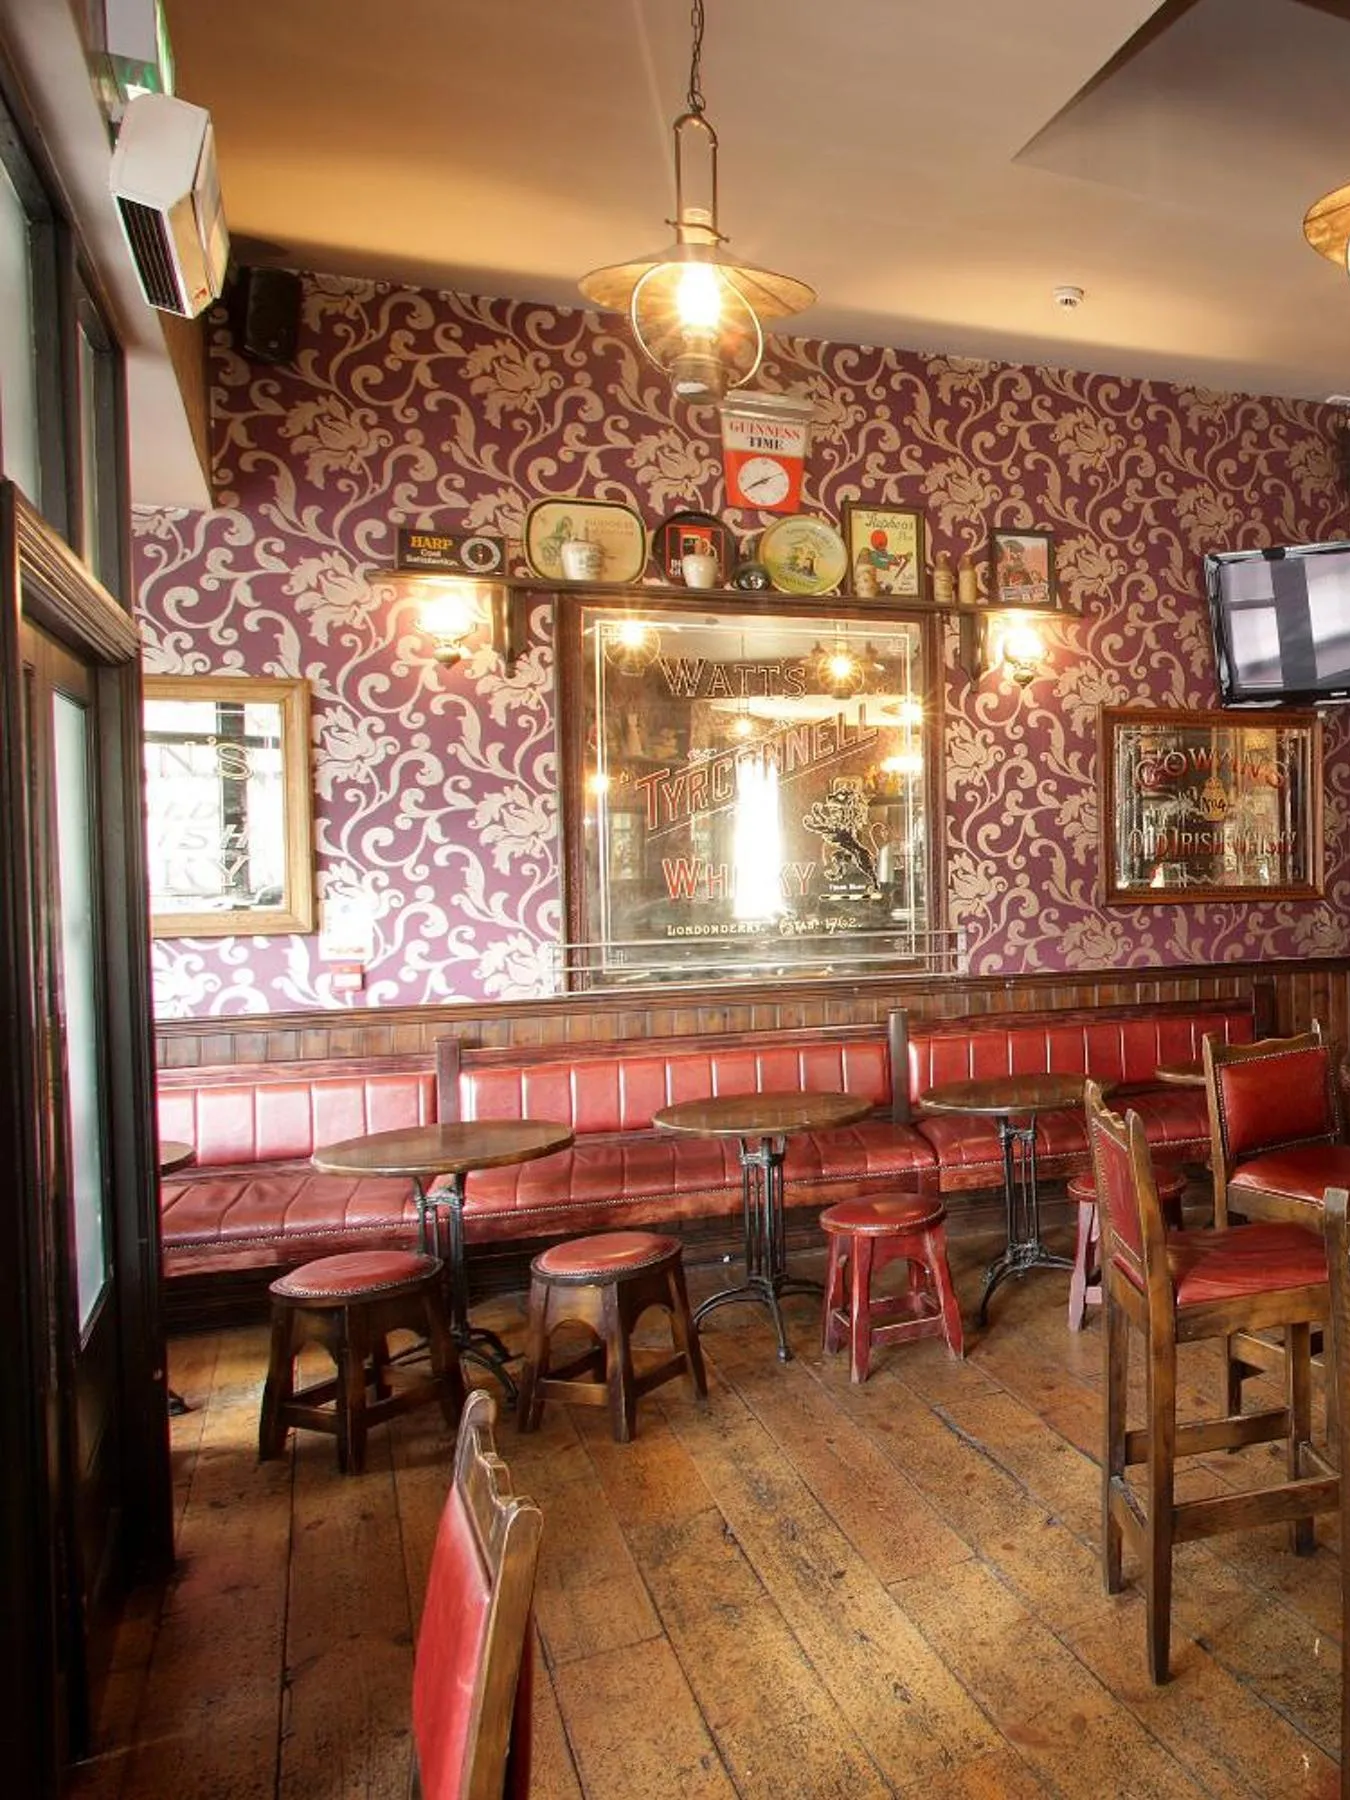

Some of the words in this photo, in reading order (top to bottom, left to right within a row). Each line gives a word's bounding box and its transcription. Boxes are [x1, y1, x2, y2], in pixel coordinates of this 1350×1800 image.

[730, 420, 801, 440] GUINNESS
[749, 437, 784, 450] TIME
[410, 535, 454, 550] HARP
[658, 656, 808, 700] WATT'S
